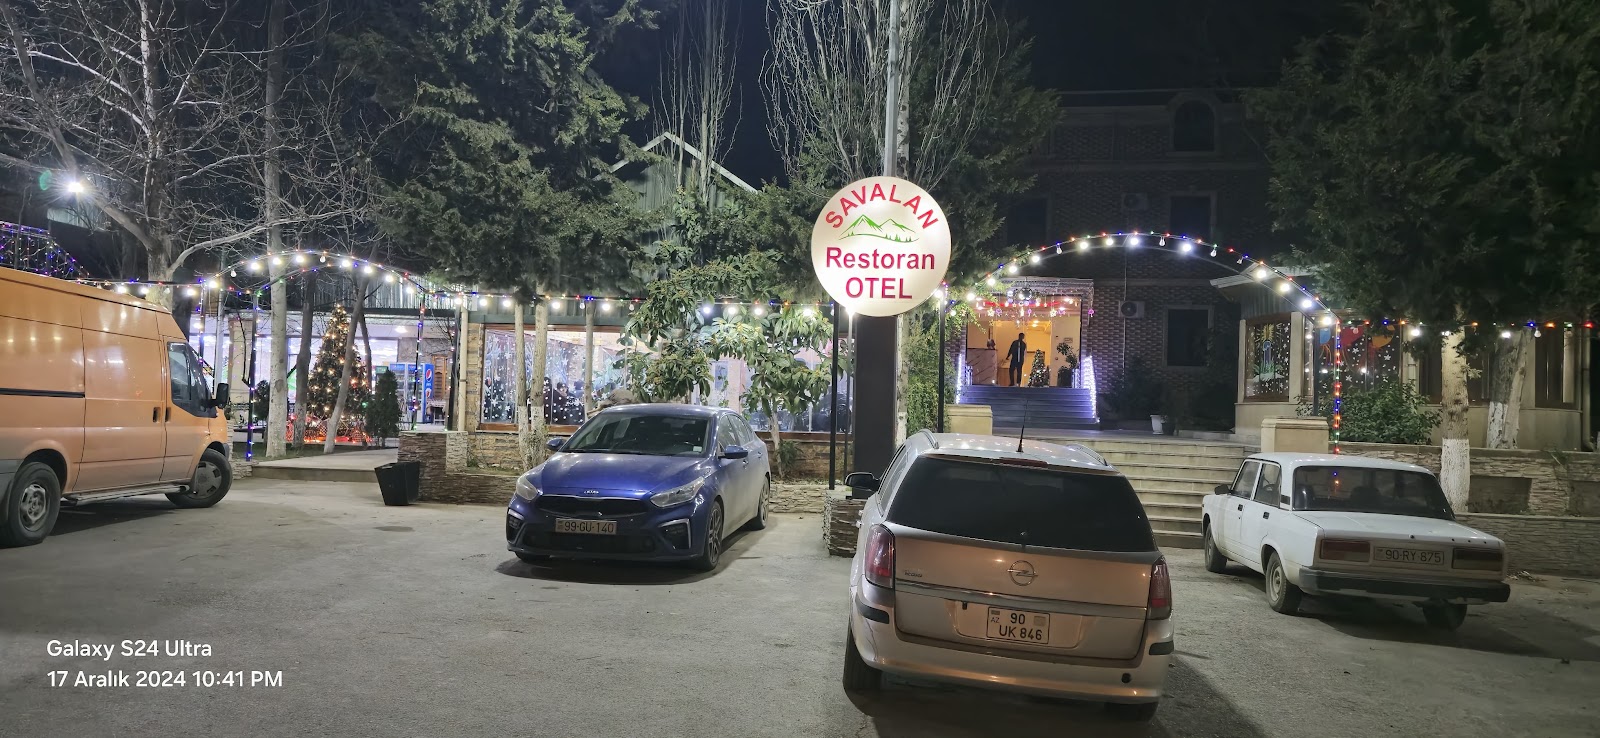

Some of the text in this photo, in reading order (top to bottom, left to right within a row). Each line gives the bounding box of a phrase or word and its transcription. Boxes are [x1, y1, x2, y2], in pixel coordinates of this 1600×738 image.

[825, 183, 939, 229] SAVALAN
[826, 247, 935, 270] Restoran
[845, 277, 913, 299] OTEL
[1010, 612, 1026, 625] 90
[999, 624, 1043, 641] UK 846
